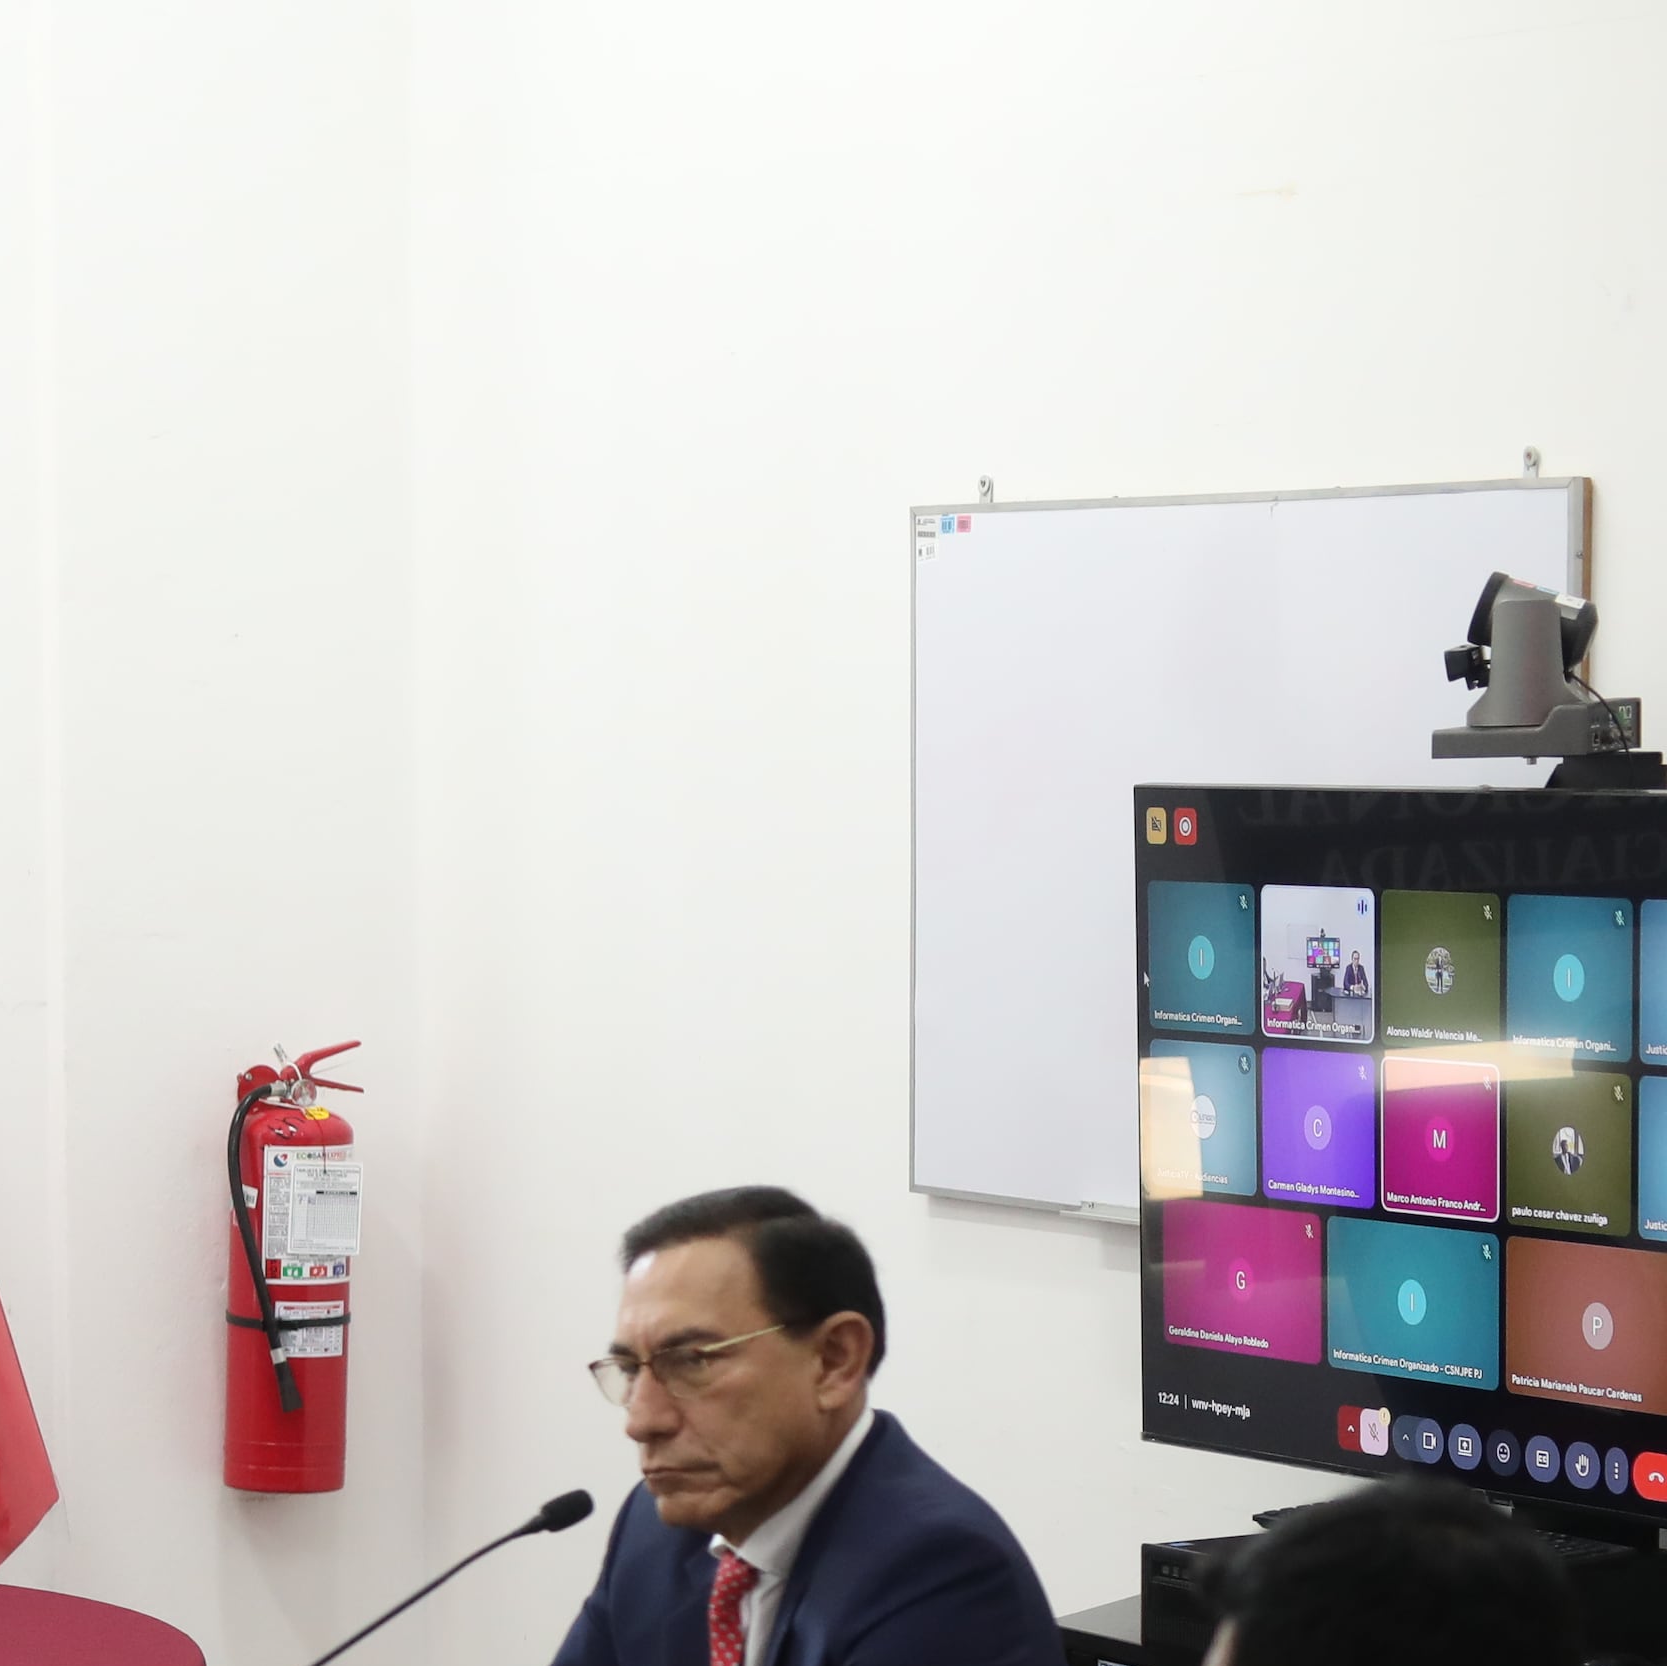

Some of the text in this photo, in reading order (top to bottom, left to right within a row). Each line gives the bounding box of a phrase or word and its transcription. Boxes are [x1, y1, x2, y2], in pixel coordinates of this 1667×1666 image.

[1154, 1010, 1190, 1022] Informatica
[1191, 1013, 1215, 1024] Crimen
[1267, 1018, 1305, 1030] Informatica
[1306, 1021, 1331, 1032] Crimen
[1386, 1026, 1410, 1038] Alonso
[1434, 1029, 1464, 1041] Valencia
[1268, 1179, 1295, 1192] Carmen
[1295, 1182, 1318, 1195] Gladys
[1387, 1191, 1410, 1204] Marco
[1410, 1194, 1437, 1207] Antonio
[1438, 1196, 1463, 1209] Franco
[1512, 1206, 1533, 1219] paulo
[1333, 1349, 1372, 1364] Informatica
[1373, 1355, 1399, 1367] Crimen
[1399, 1359, 1439, 1373] Organizado
[1512, 1374, 1540, 1388] Patricia
[1578, 1383, 1605, 1396] Paucar
[1605, 1387, 1643, 1403] Cardenas
[1158, 1392, 1180, 1406] 12:24
